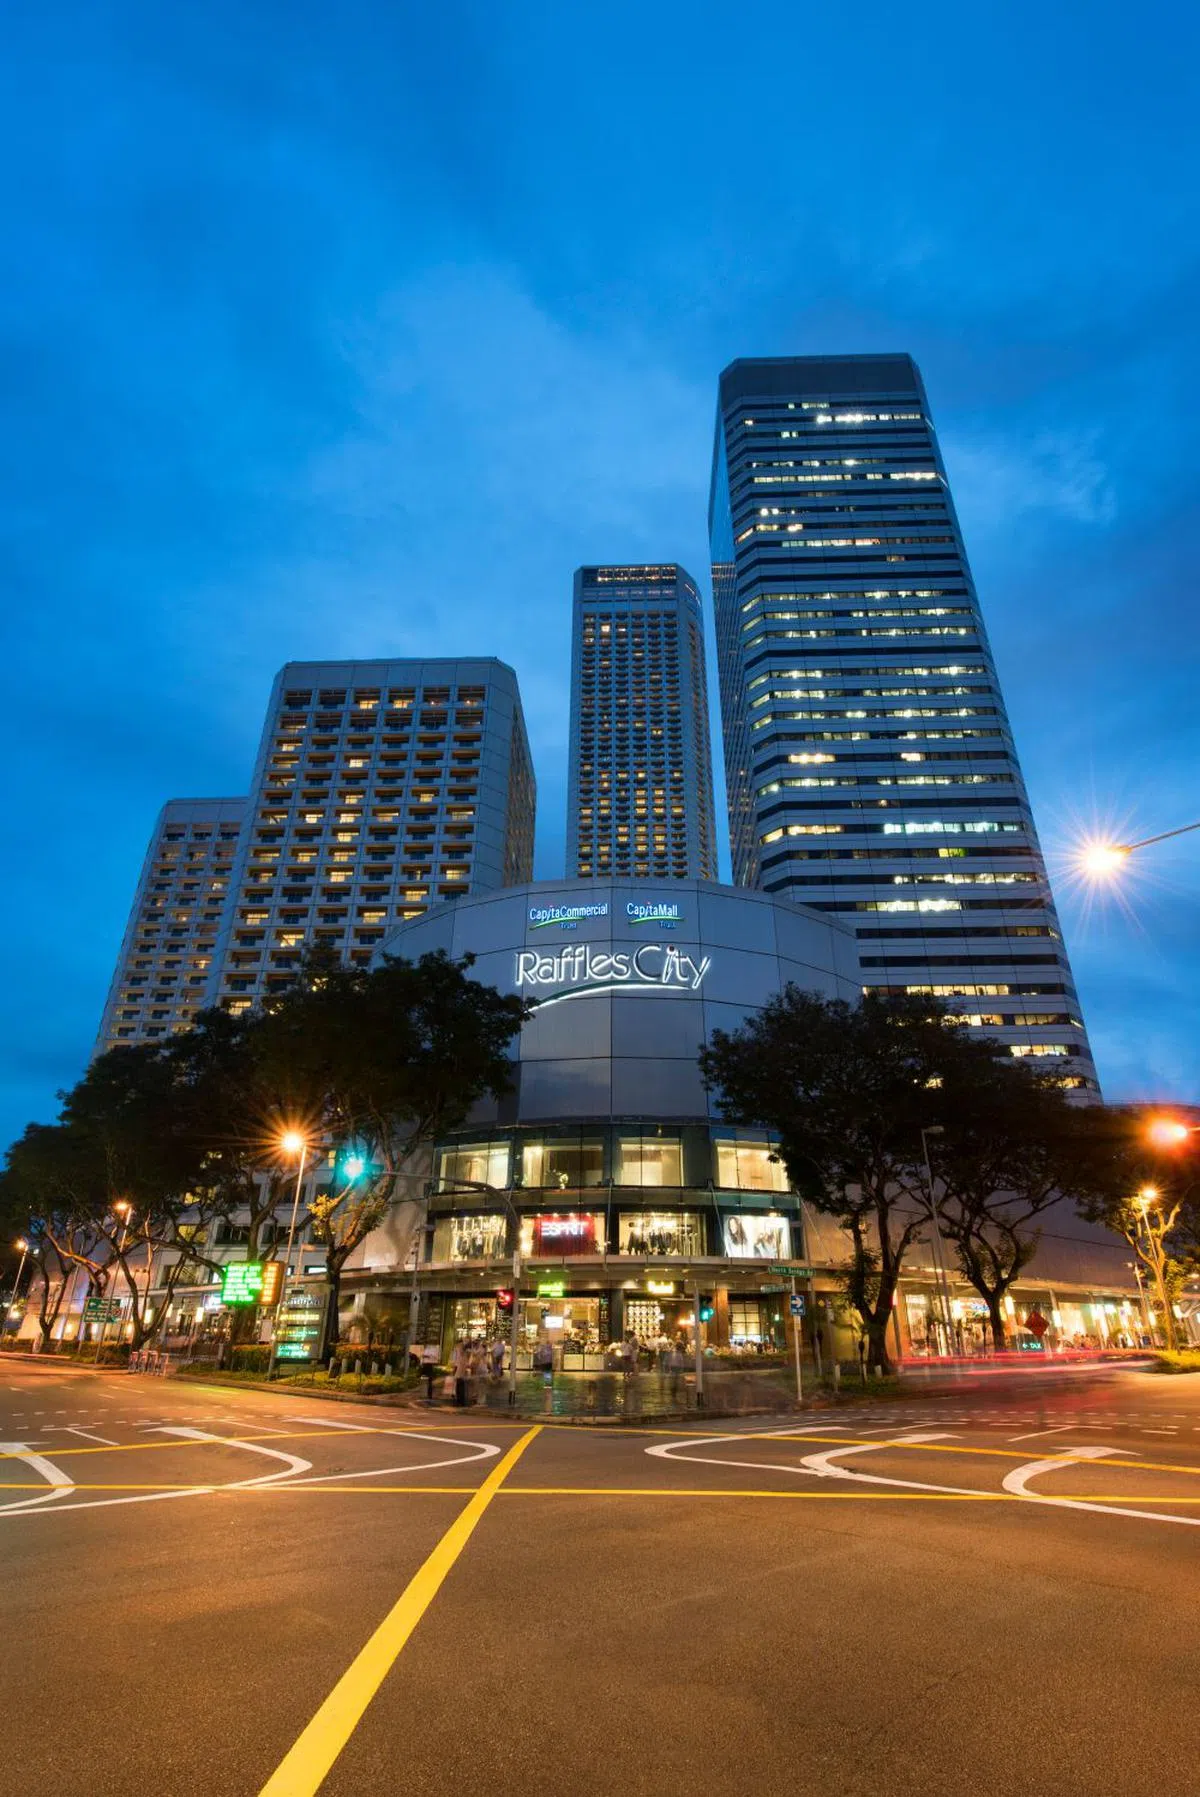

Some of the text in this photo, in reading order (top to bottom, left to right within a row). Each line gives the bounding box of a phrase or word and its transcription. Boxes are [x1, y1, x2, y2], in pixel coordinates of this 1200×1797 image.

[529, 903, 608, 920] CapitaCommercial
[627, 901, 678, 918] CapitaMall
[515, 944, 711, 989] Raffles City
[541, 1221, 587, 1236] ESPRIT
